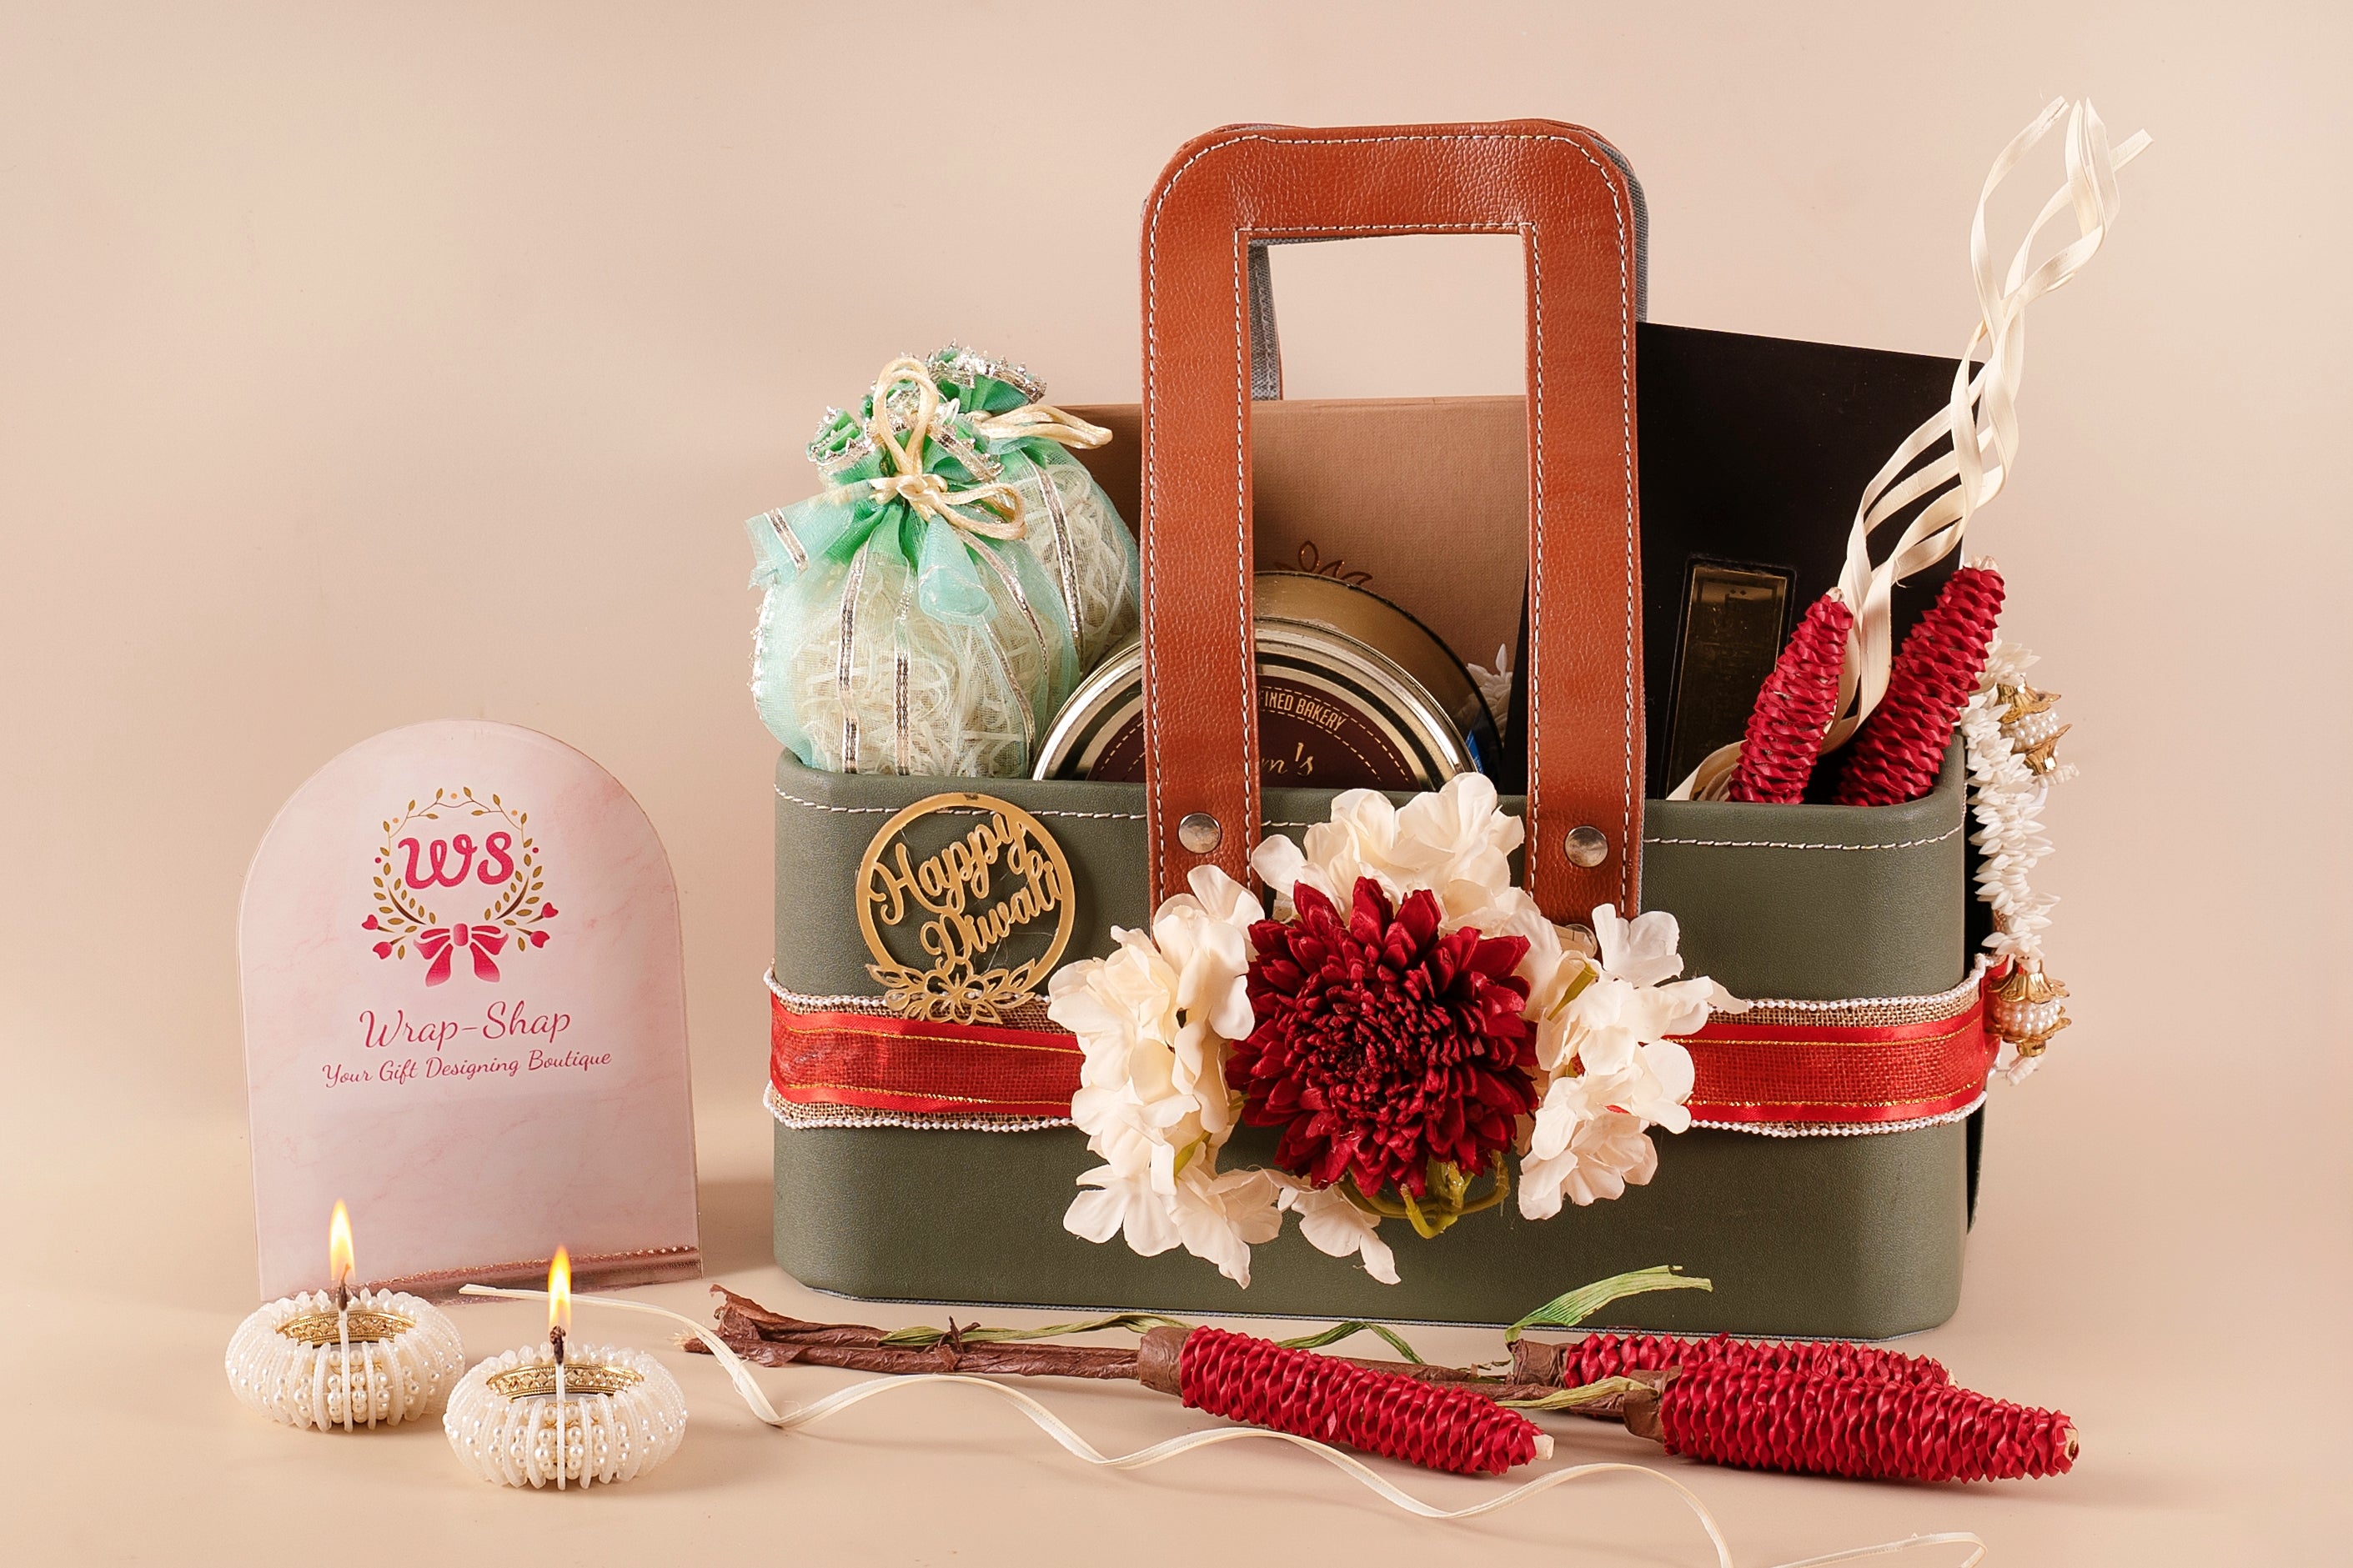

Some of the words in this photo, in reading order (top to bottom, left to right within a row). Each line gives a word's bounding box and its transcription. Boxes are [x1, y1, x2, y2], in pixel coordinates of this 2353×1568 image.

[1295, 698, 1347, 732] BAKERY
[870, 812, 1028, 925] Happy
[920, 849, 1062, 964] Diwali
[359, 999, 572, 1052] Wrap-Shap
[322, 1063, 374, 1088] Your
[379, 1058, 418, 1085] Gift
[425, 1055, 520, 1080] Designing
[528, 1048, 612, 1072] Boutique
